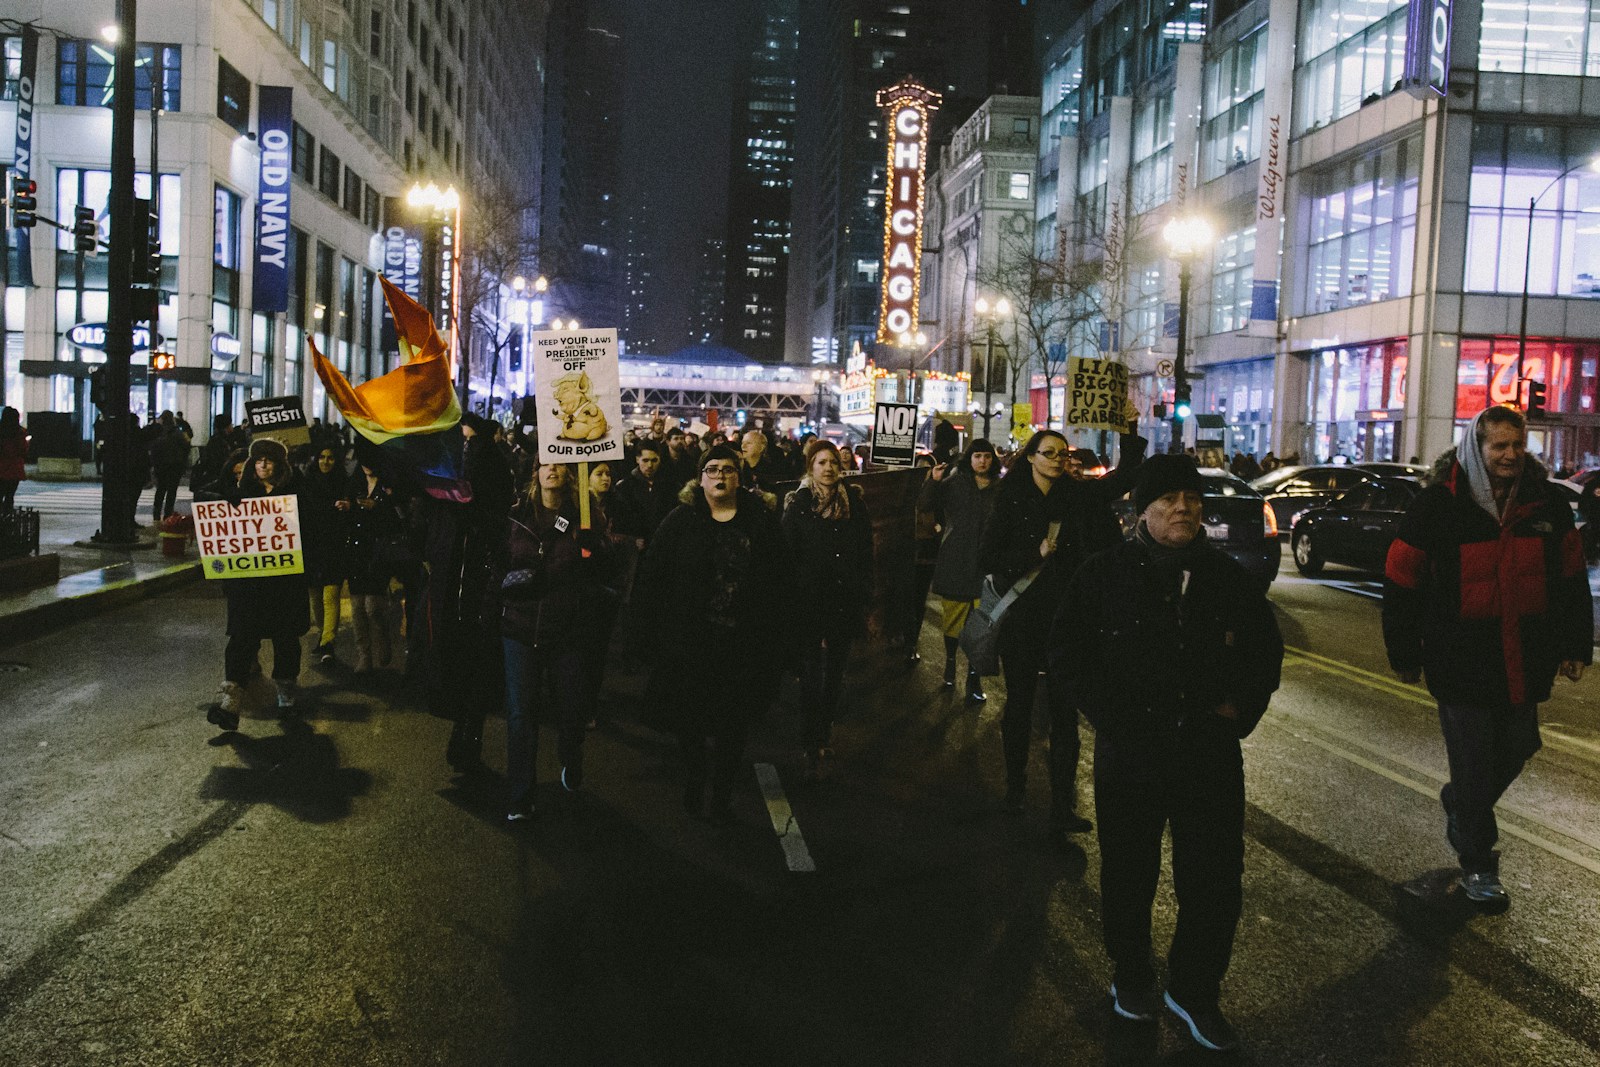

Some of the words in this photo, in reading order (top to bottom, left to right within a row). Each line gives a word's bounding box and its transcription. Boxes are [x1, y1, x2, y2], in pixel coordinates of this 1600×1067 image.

[1430, 0, 1450, 88] JO
[19, 76, 33, 141] OLD
[262, 129, 289, 187] OLD
[1259, 114, 1284, 220] Walgreens
[260, 192, 288, 269] NAVY
[886, 109, 920, 333] CHICAGO
[386, 226, 405, 266] OLD
[546, 348, 606, 358] PRESIDENT'S
[560, 336, 588, 345] YOUR
[563, 361, 586, 371] OFF
[252, 408, 301, 426] RESIST!
[877, 405, 916, 436] NO!
[547, 444, 573, 455] OUR
[576, 440, 617, 456] BODIES
[201, 517, 264, 538] UNITY
[274, 516, 289, 533] &
[202, 533, 296, 556] RESPECT
[228, 553, 295, 570] ICIRR
